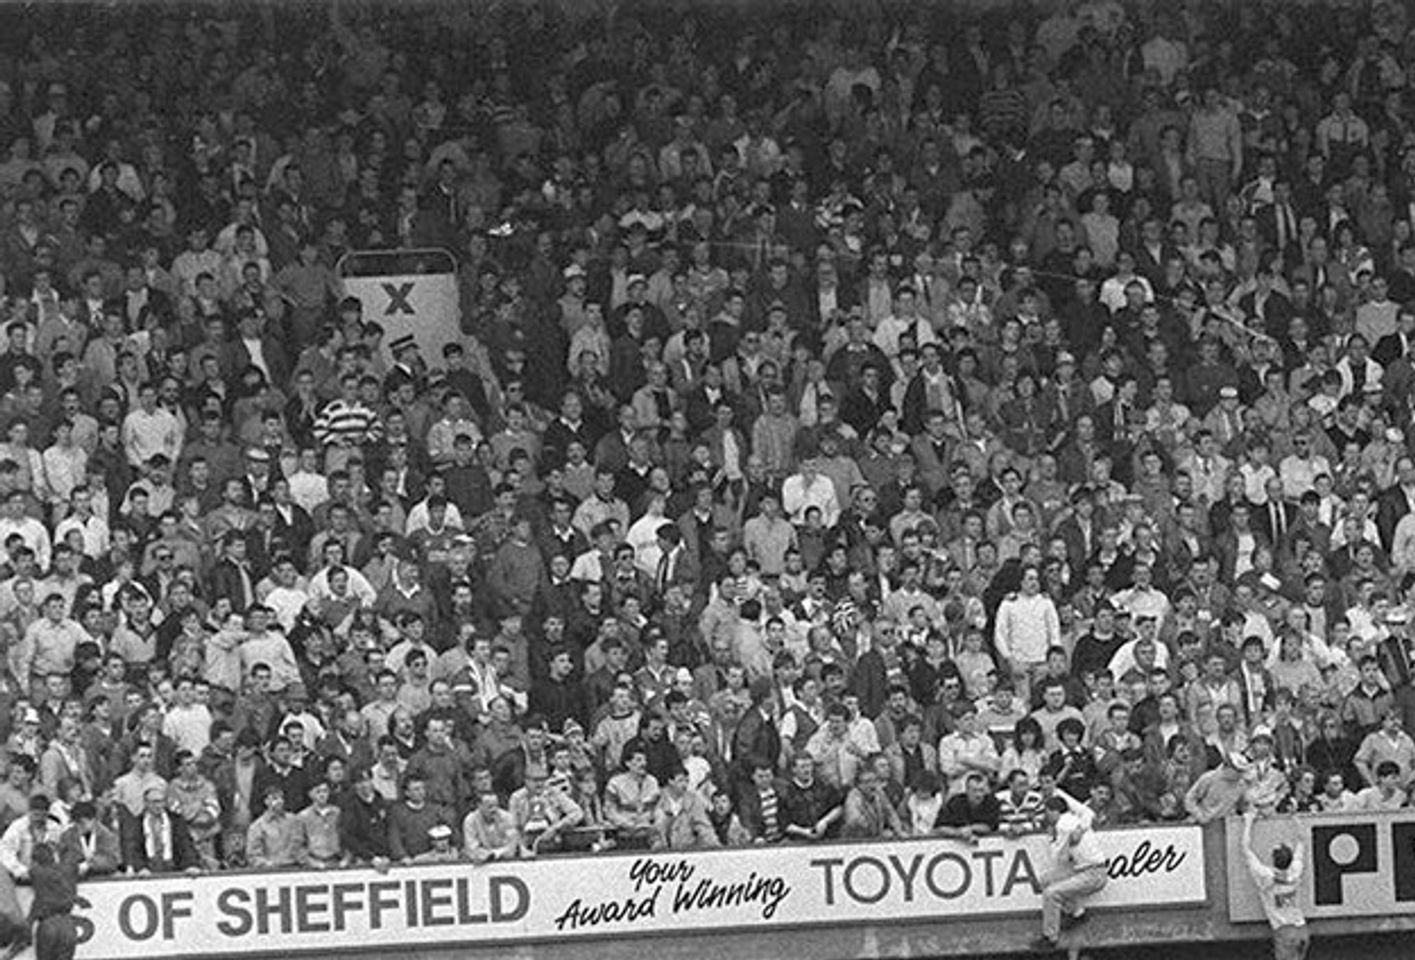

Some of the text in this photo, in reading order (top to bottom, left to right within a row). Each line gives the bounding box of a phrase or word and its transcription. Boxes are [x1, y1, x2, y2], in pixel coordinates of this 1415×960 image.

[381, 282, 416, 315] X
[629, 858, 695, 892] Your
[810, 839, 1187, 904] TOYOTA aler
[117, 891, 194, 942] OF
[216, 876, 531, 936] SHEFFIELD
[555, 872, 791, 930] Award Winning
